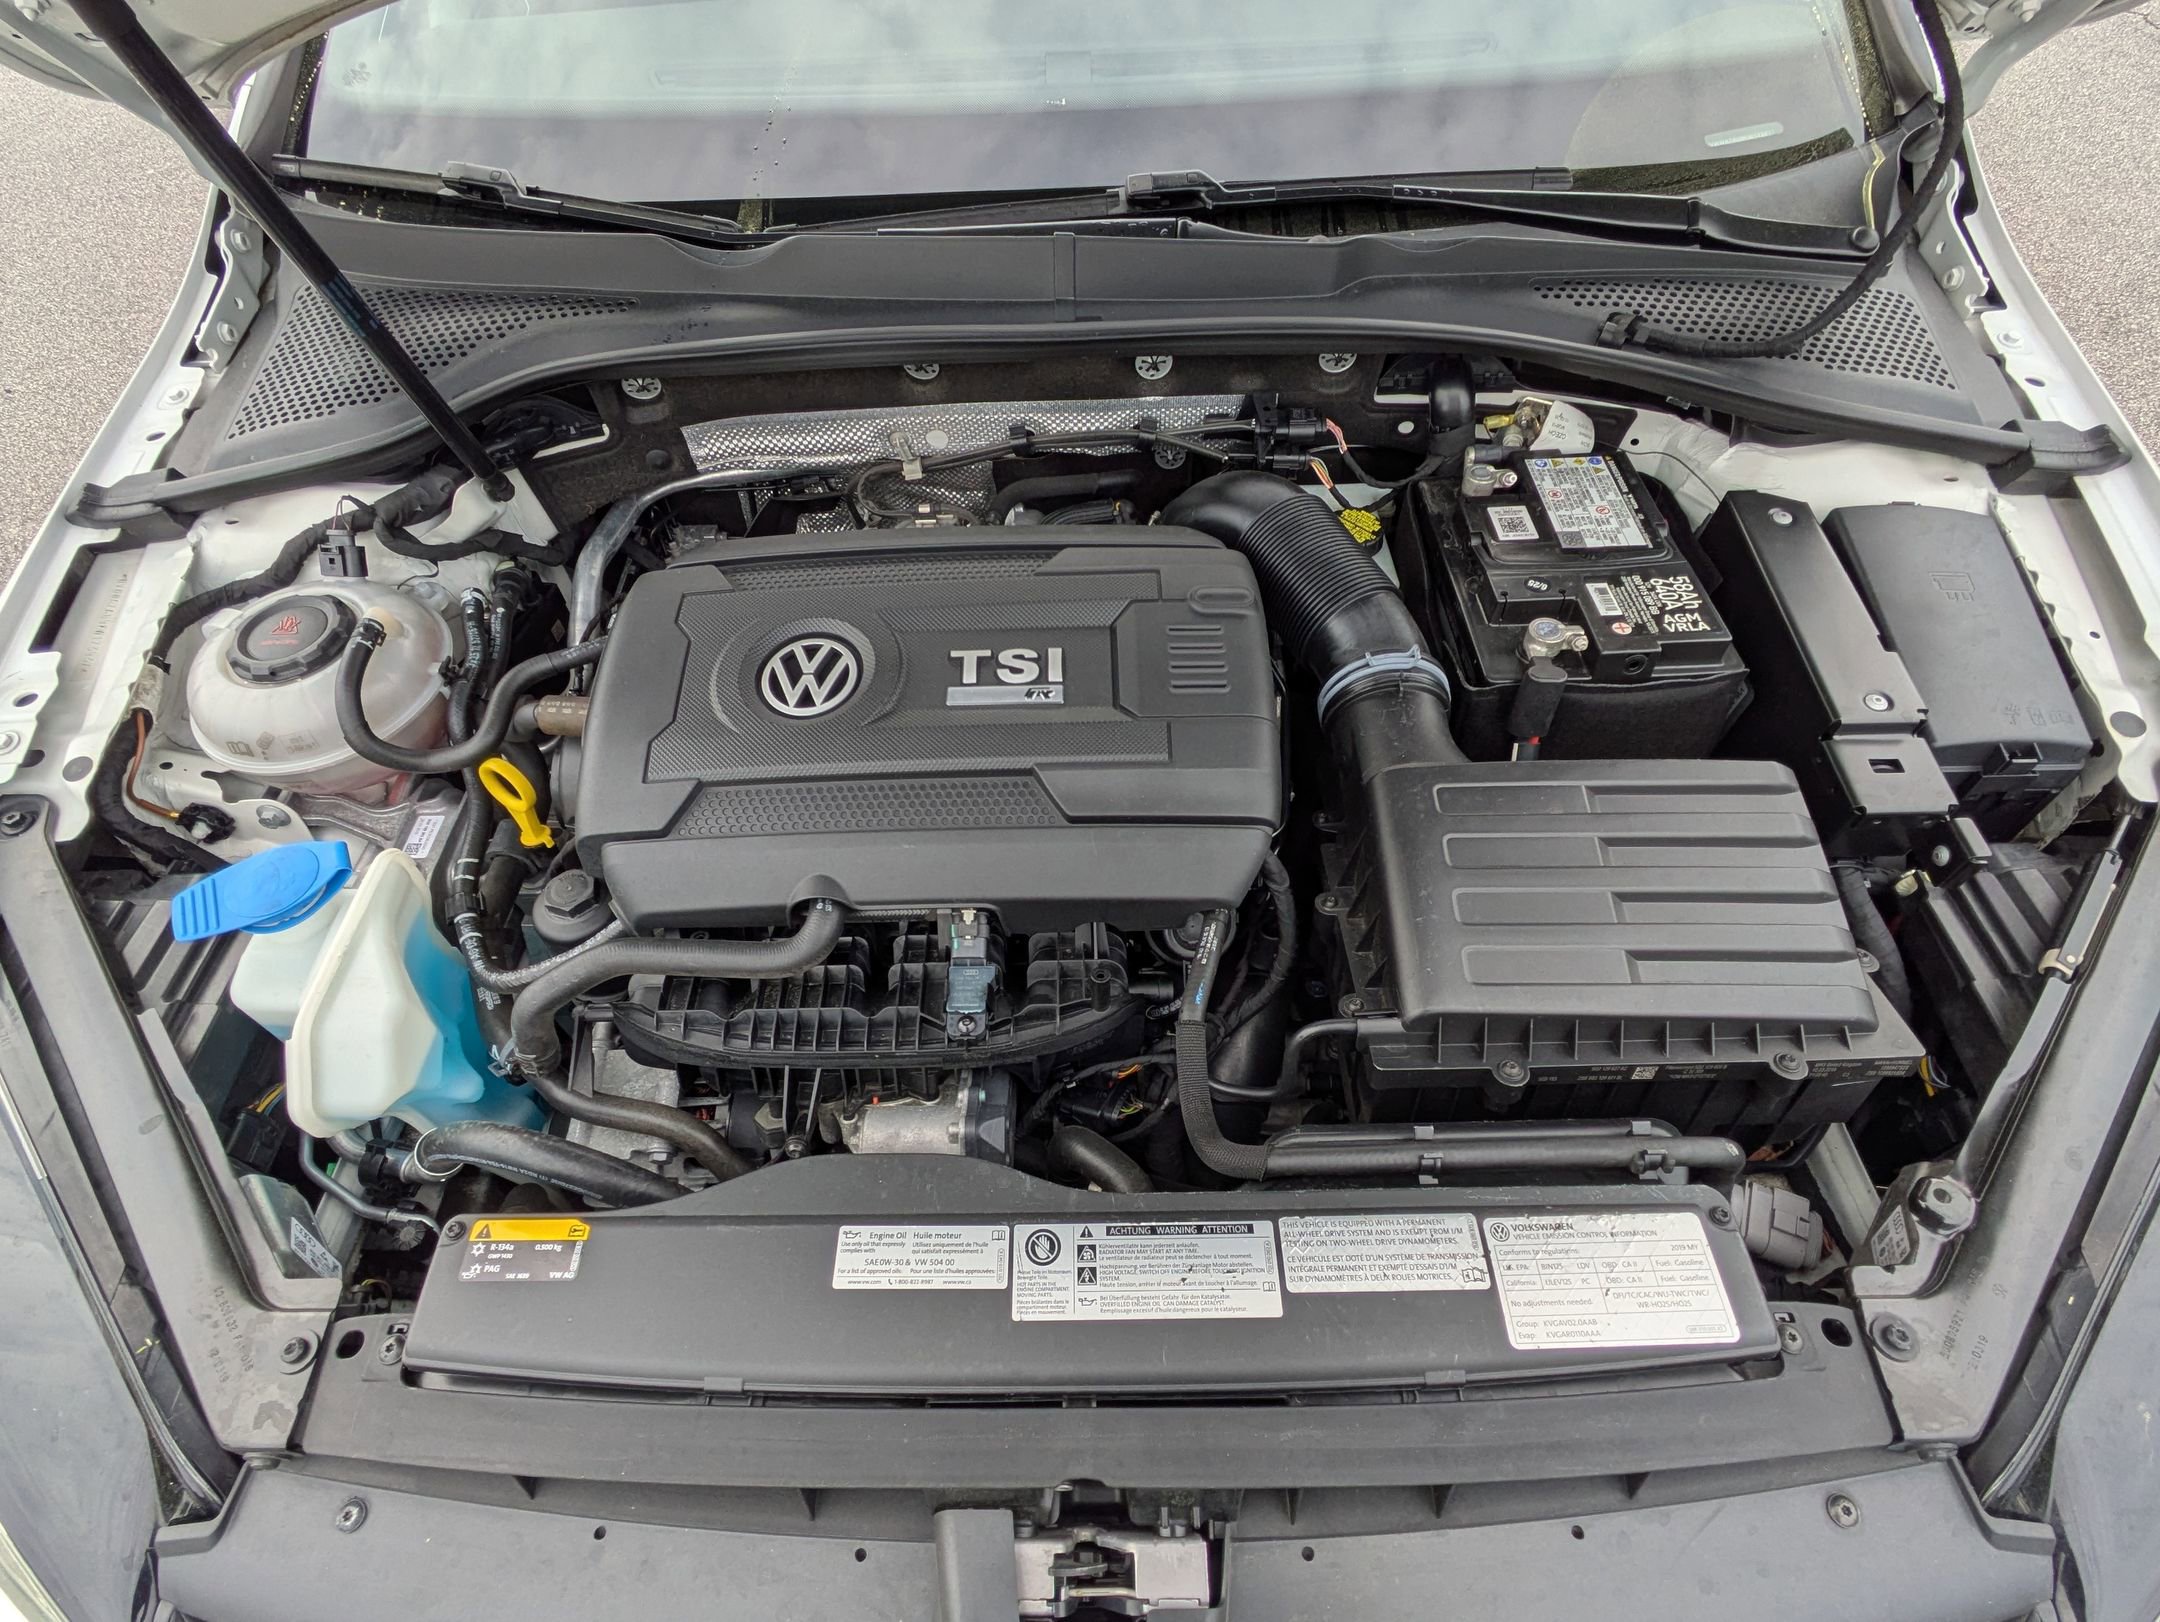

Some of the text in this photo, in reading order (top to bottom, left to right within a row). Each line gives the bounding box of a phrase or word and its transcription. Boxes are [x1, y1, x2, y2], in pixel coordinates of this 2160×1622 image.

[1651, 578, 1682, 610] 640A
[1669, 576, 1702, 609] 58Ah
[1664, 613, 1701, 623] AGM
[1663, 623, 1711, 632] VRLA
[950, 648, 1062, 683] TSI
[1338, 1220, 1374, 1228] EQUIPPED
[1110, 1225, 1248, 1235] ACHTUNG WARNING ATTENTION
[1401, 1228, 1427, 1236] EXEMPT
[870, 1232, 895, 1240] Engine
[1345, 1254, 1364, 1262] DOTÉ
[1365, 1254, 1384, 1262] D'UN
[1288, 1264, 1325, 1273] INTÉGRALE
[1378, 1263, 1407, 1271] EXEMPTÉ
[1371, 1273, 1390, 1281] DEUX
[1392, 1273, 1416, 1281] ROUES
[1523, 1300, 1564, 1308] adjustments
